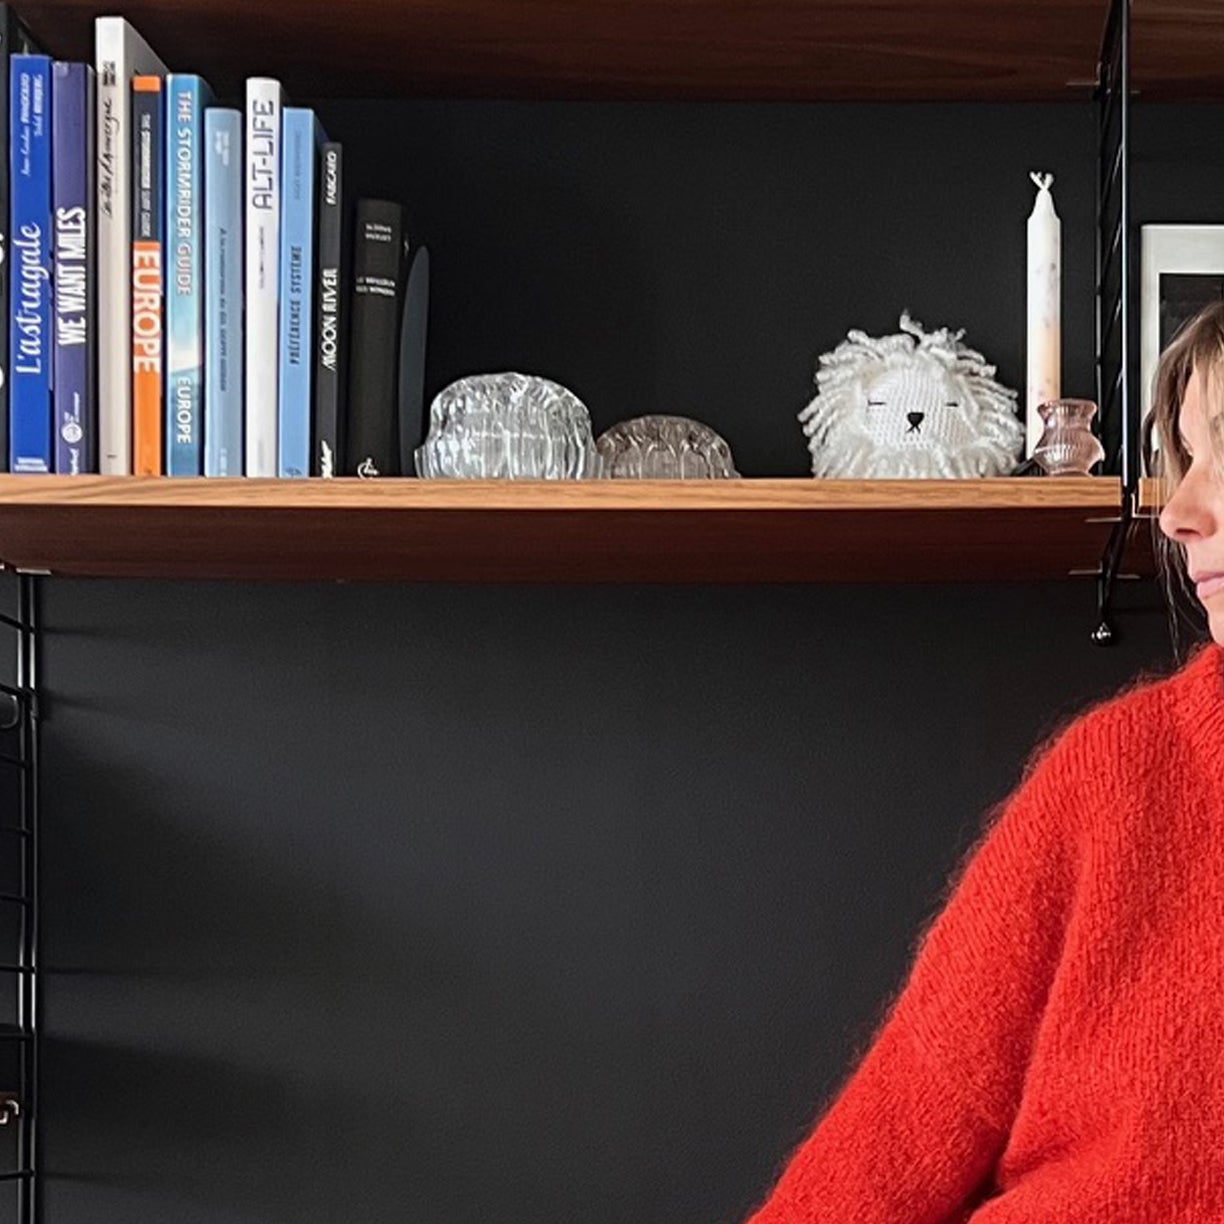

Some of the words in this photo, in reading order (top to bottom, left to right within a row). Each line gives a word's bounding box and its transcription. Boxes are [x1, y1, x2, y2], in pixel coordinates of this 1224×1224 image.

[177, 91, 192, 123] THE
[252, 98, 273, 210] ALT-LIFE
[176, 127, 192, 238] STORMRIDER
[57, 206, 86, 260] MILES
[57, 262, 86, 314] WANT
[176, 242, 192, 296] GUIDE
[322, 268, 338, 313] RIVER
[14, 222, 49, 375] L'astragale
[133, 249, 161, 374] EUROPE
[57, 317, 86, 346] WE
[322, 316, 338, 371] MOON
[176, 376, 192, 445] EUROPE
